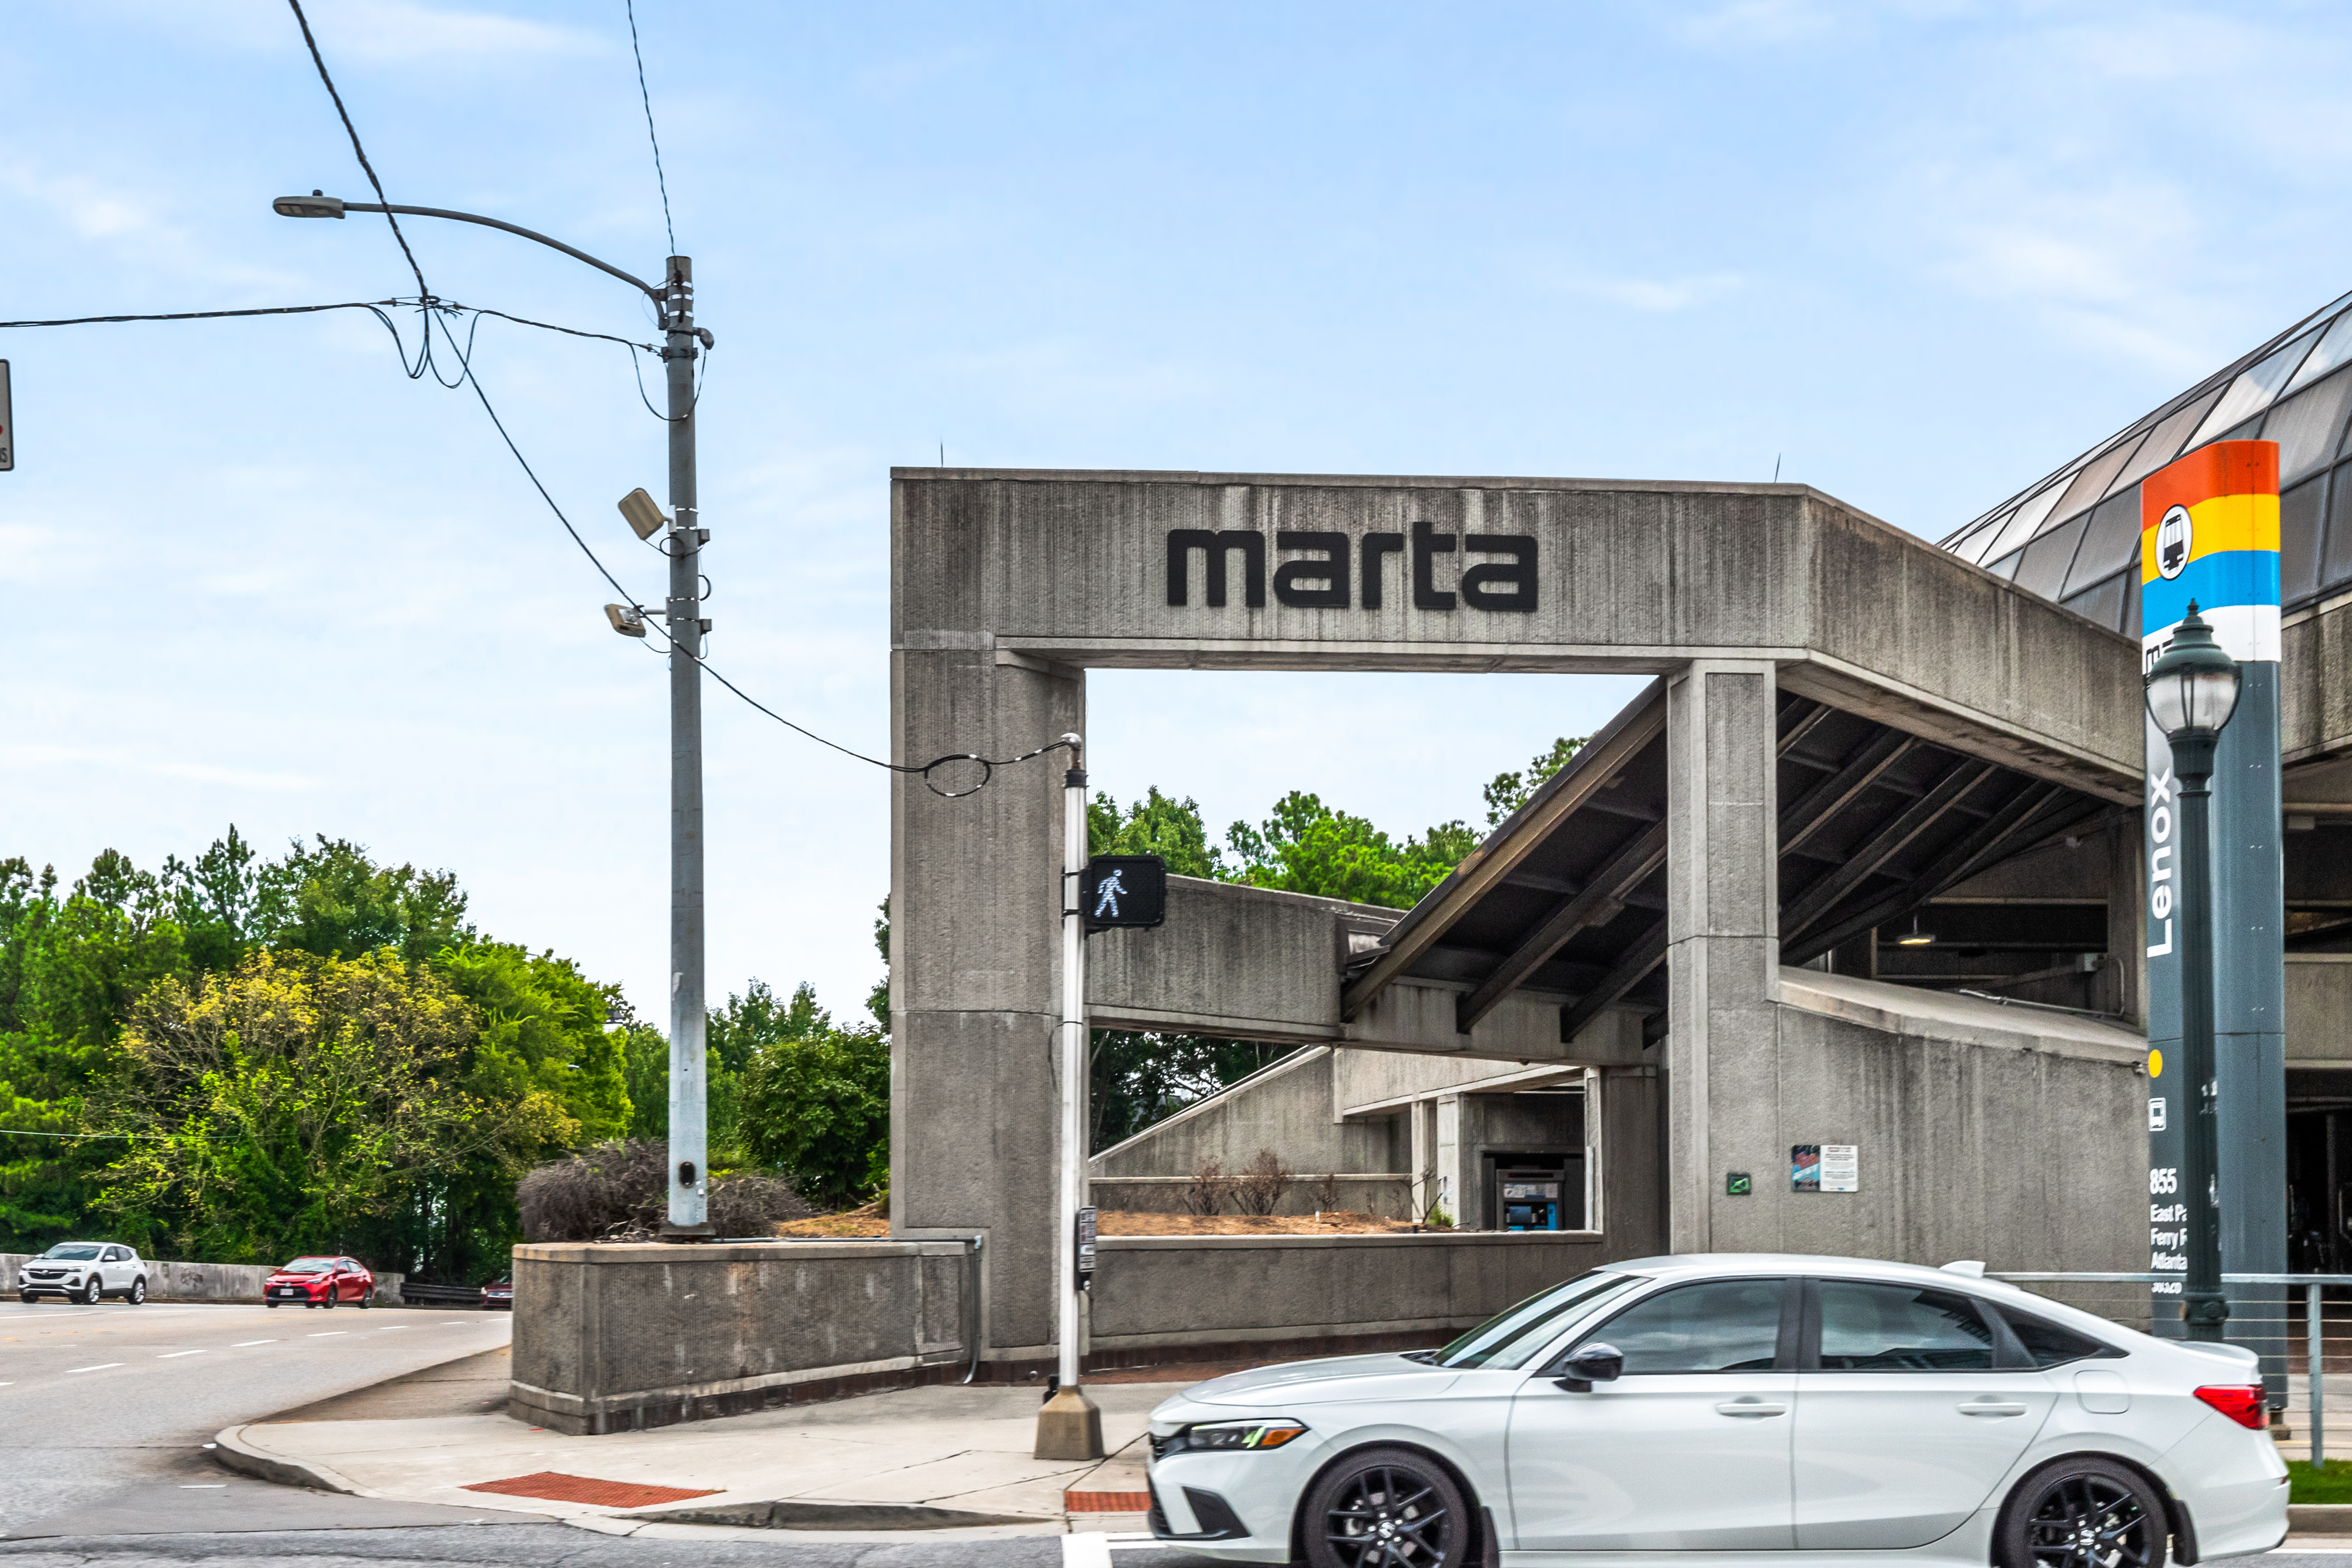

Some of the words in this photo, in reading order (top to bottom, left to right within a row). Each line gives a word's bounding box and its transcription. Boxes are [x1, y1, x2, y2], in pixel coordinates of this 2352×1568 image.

[1167, 521, 1538, 611] marta
[2147, 767, 2172, 958] Lenox
[2150, 1168, 2177, 1194] 855
[2150, 1204, 2174, 1222] East
[2151, 1228, 2179, 1251] Ferry
[2151, 1252, 2187, 1270] Atlanta
